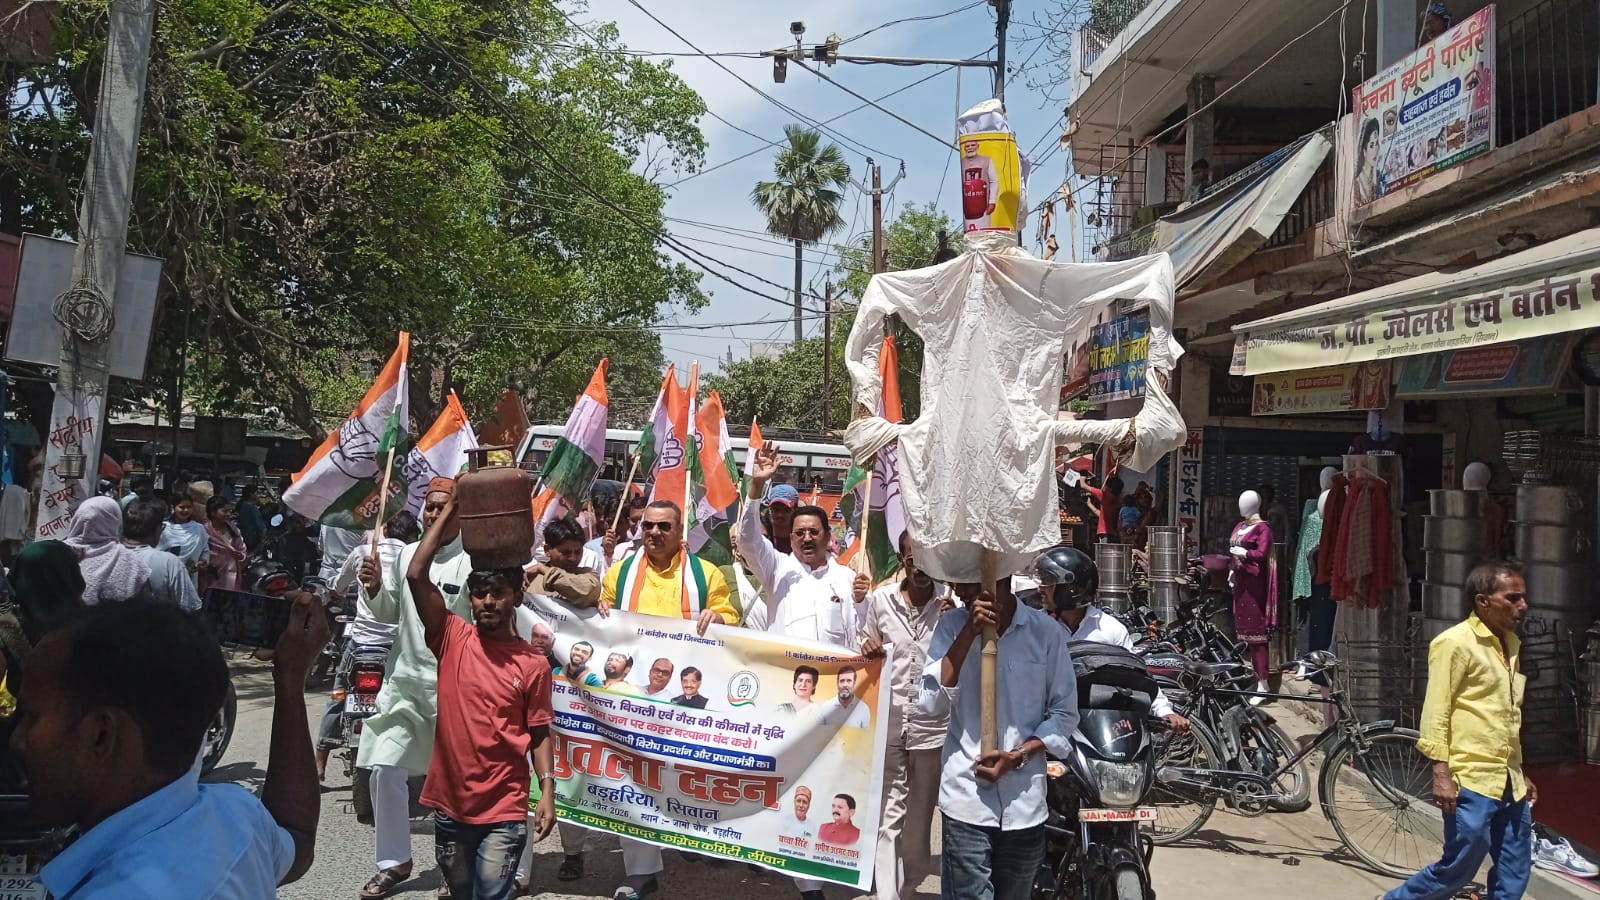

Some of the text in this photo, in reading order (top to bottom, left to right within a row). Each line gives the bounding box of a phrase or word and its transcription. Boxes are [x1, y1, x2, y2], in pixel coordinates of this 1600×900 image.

[1361, 78, 1396, 116] रचना
[1400, 45, 1436, 96] ब्यूटी
[1509, 274, 1581, 319] बर्तन
[645, 629, 668, 639] कांग्रेस
[568, 685, 581, 698] की
[620, 699, 656, 717] बिजली
[658, 709, 674, 721] एवं
[676, 712, 696, 725] गैस
[698, 716, 713, 728] की
[715, 719, 751, 734] कीमतों
[752, 723, 763, 735] में
[764, 726, 785, 740] वृद्धि
[569, 700, 587, 713] कर
[588, 706, 606, 720] आम
[608, 714, 628, 726] जन
[630, 719, 645, 730] पर
[646, 724, 673, 736] कहर
[675, 727, 711, 742] बरपाना
[713, 732, 729, 745] बंद
[582, 720, 595, 731] का
[636, 736, 661, 750] विरोध
[662, 744, 693, 757] प्रदर्शन
[693, 749, 712, 760] और
[713, 752, 755, 769] प्रधानमंत्री
[756, 760, 770, 769] का
[667, 797, 719, 820] सिवान
[673, 763, 785, 811] दहन
[640, 813, 659, 824] स्थान
[1084, 810, 1150, 820] JAI MATA DI
[580, 814, 608, 829] नगर
[609, 820, 627, 833] एवं
[660, 833, 699, 849] कांग्रेस
[747, 849, 787, 866] सीवान
